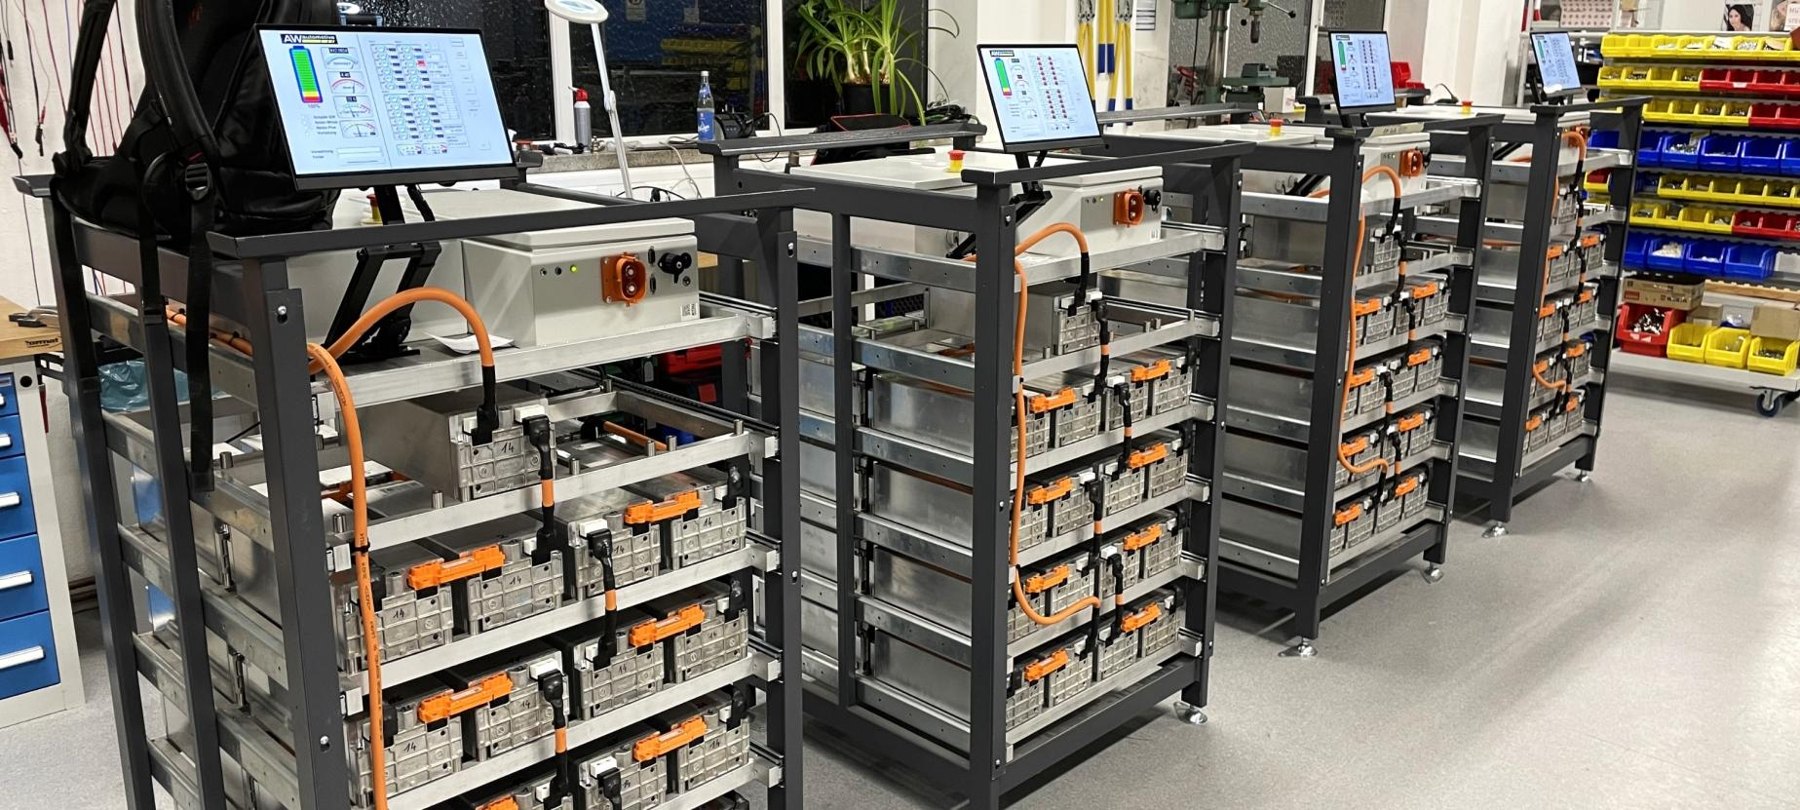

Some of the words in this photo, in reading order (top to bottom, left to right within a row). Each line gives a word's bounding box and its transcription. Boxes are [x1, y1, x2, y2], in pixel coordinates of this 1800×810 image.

[284, 34, 302, 43] AW
[501, 441, 515, 454] 14
[508, 575, 523, 586] 14
[392, 608, 406, 620] 14
[519, 699, 532, 709] 14
[403, 741, 417, 753] 14
